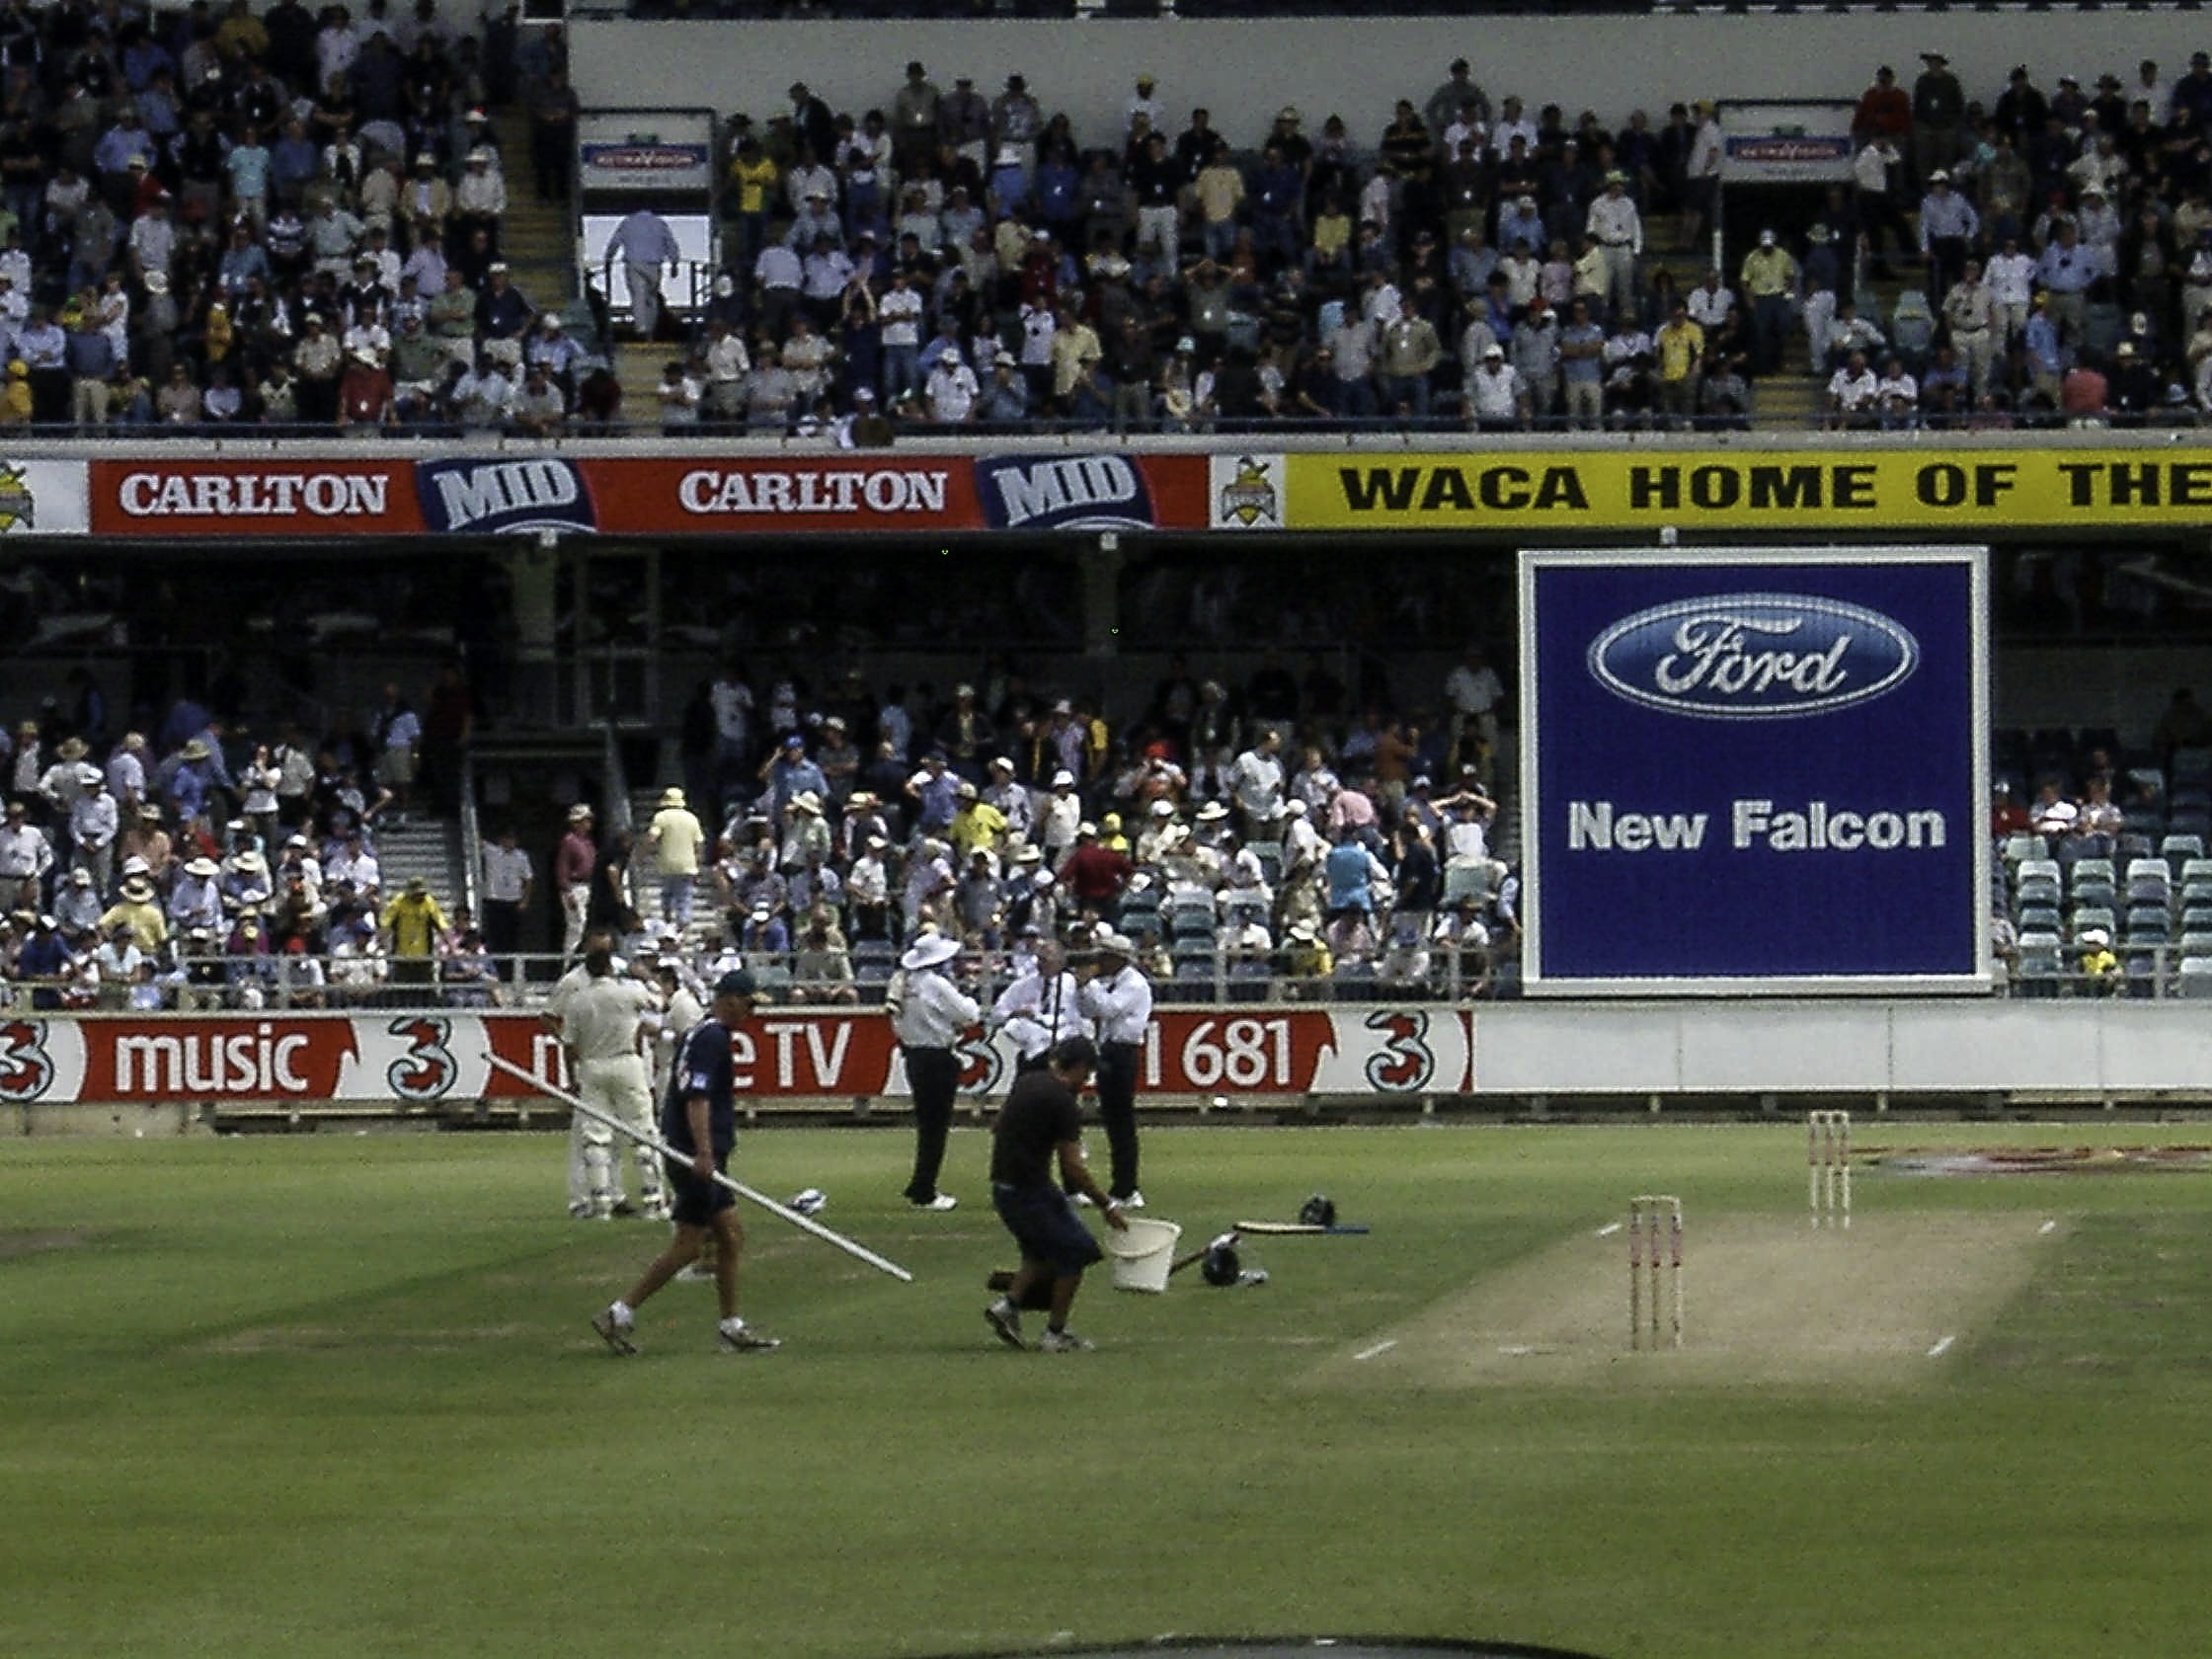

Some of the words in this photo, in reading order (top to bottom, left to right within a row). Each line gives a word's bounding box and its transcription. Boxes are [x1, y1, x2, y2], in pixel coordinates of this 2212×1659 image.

[119, 474, 389, 515] CARLTON
[432, 459, 578, 529] MID
[679, 471, 949, 513] CARLTON
[991, 455, 1137, 526] MID
[1339, 467, 1590, 512] WACA
[1630, 465, 1877, 510] HOME
[1917, 464, 2017, 508] OF
[2058, 462, 2212, 507] THE
[1655, 615, 1852, 694] Ford
[1568, 801, 1708, 852] New
[1732, 800, 1946, 851] Falcon
[116, 1023, 309, 1092] music
[763, 1022, 852, 1087] TV
[1182, 1018, 1291, 1086] 681
